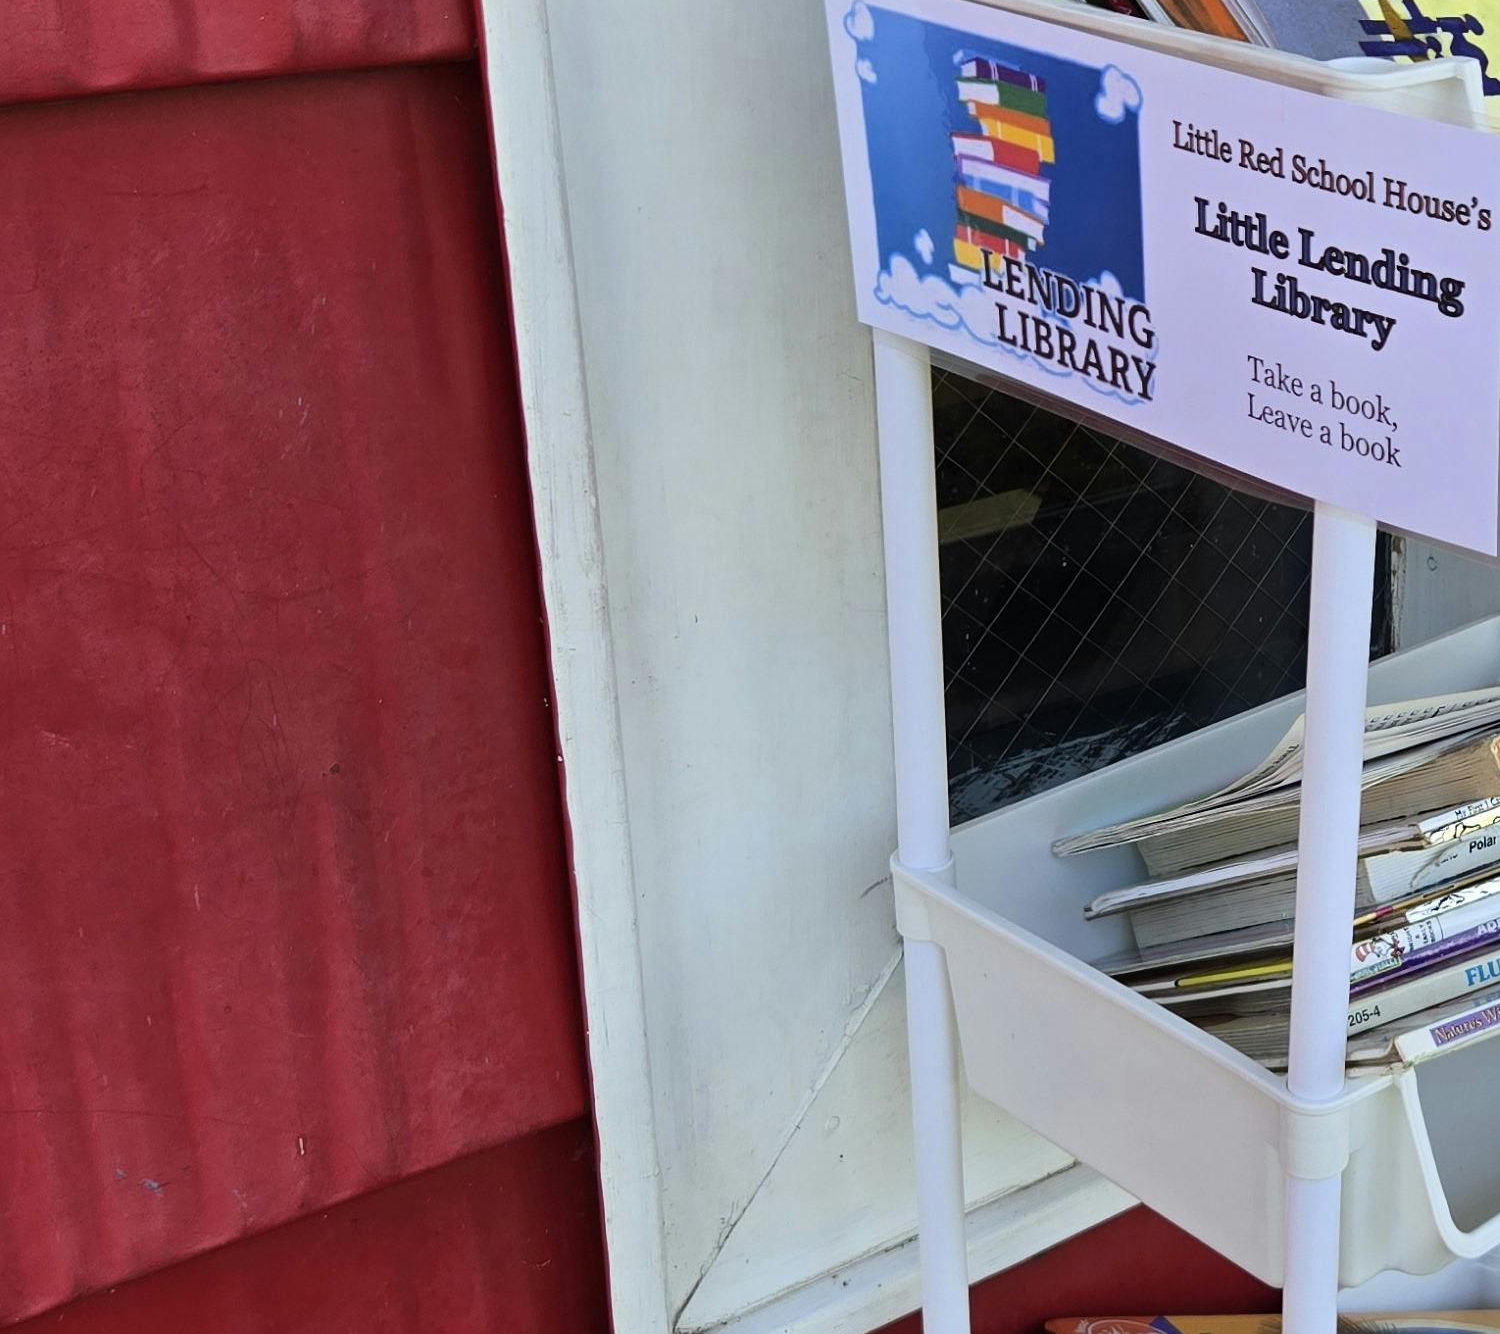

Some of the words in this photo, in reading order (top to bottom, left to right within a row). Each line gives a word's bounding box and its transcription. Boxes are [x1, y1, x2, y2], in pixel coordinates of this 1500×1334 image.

[1172, 120, 1232, 163] Little
[1238, 139, 1285, 178] Red
[1291, 154, 1376, 203] School
[1383, 177, 1492, 231] House's
[980, 248, 1155, 349] LENDING
[1194, 196, 1289, 259] Little
[1298, 226, 1465, 318] Lending
[1251, 267, 1396, 351] Library
[995, 302, 1156, 401] LIBRARY
[1247, 354, 1303, 397] Take
[1310, 381, 1323, 403] a
[1329, 380, 1398, 432] book,
[1248, 392, 1313, 438] Leave
[1320, 423, 1332, 445] a
[1340, 422, 1402, 467] book
[1468, 835, 1499, 854] Polar
[1434, 1014, 1485, 1044] Natures
